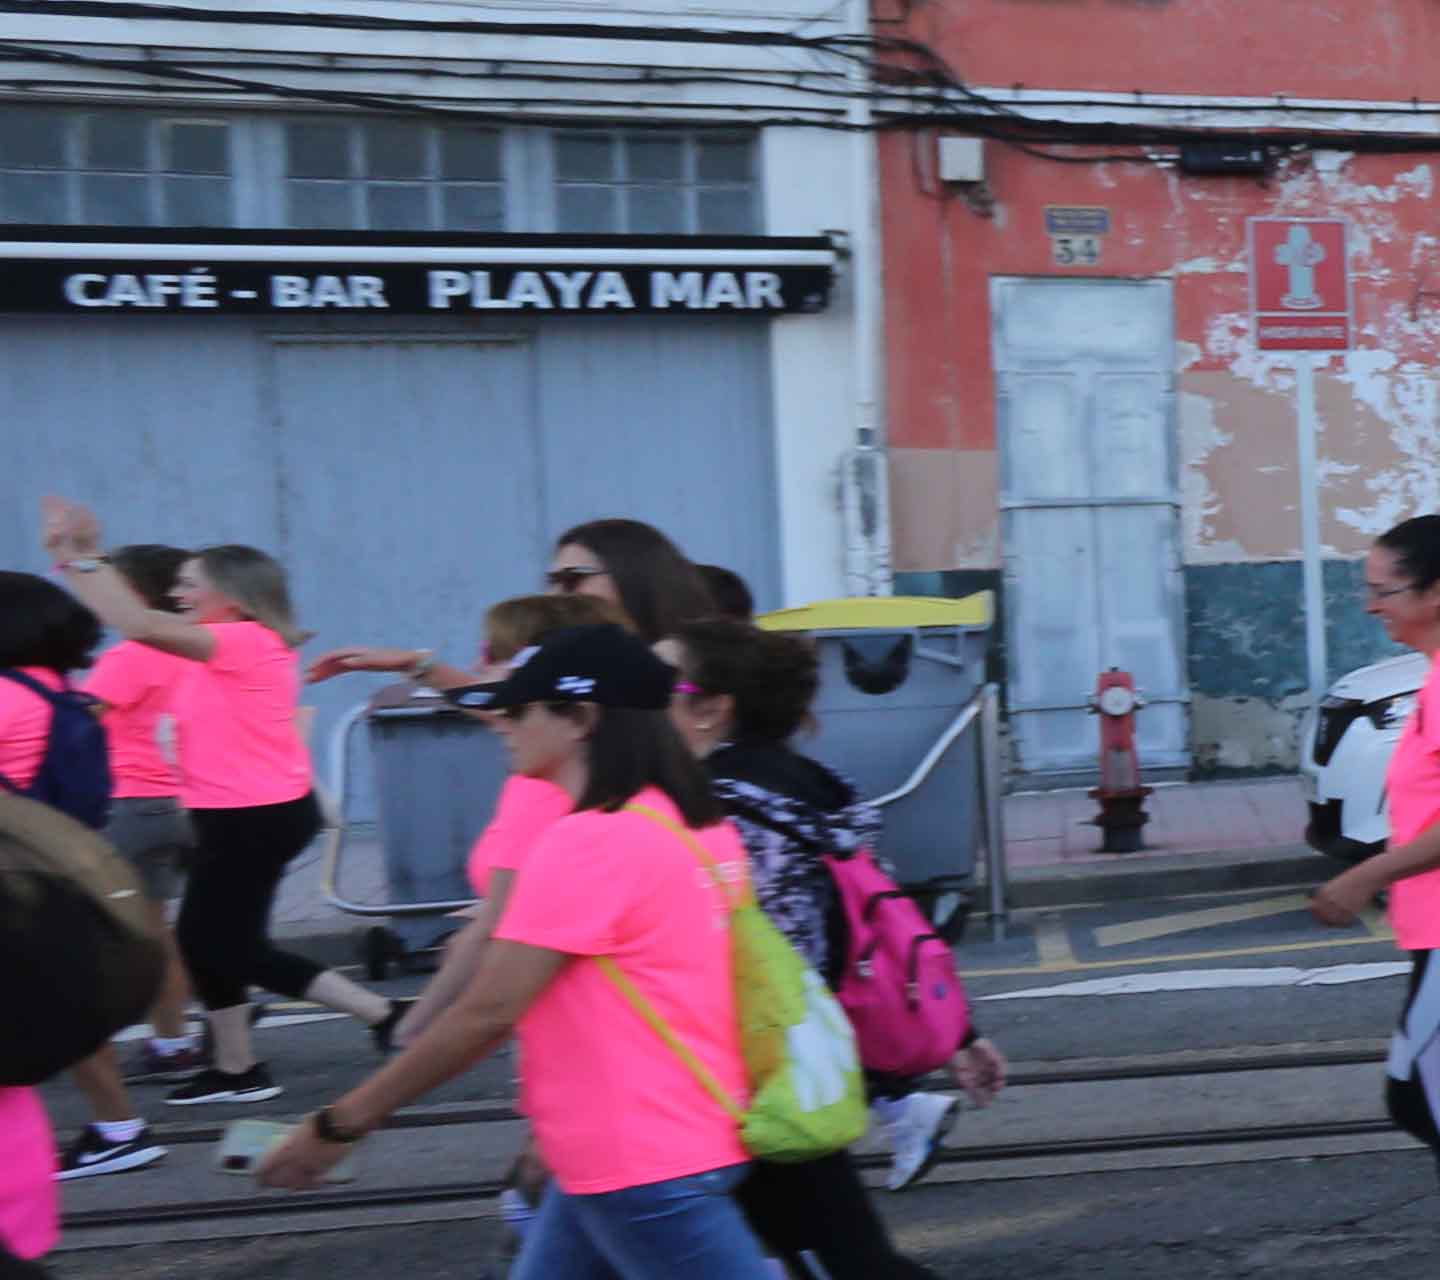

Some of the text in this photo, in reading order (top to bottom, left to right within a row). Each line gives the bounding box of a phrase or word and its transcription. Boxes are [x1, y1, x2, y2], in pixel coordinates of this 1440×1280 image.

[1056, 238, 1097, 263] 34
[65, 267, 219, 308] CAFÉ
[271, 274, 389, 308] BAR
[427, 270, 635, 310] PLAYA
[650, 271, 785, 308] MAR
